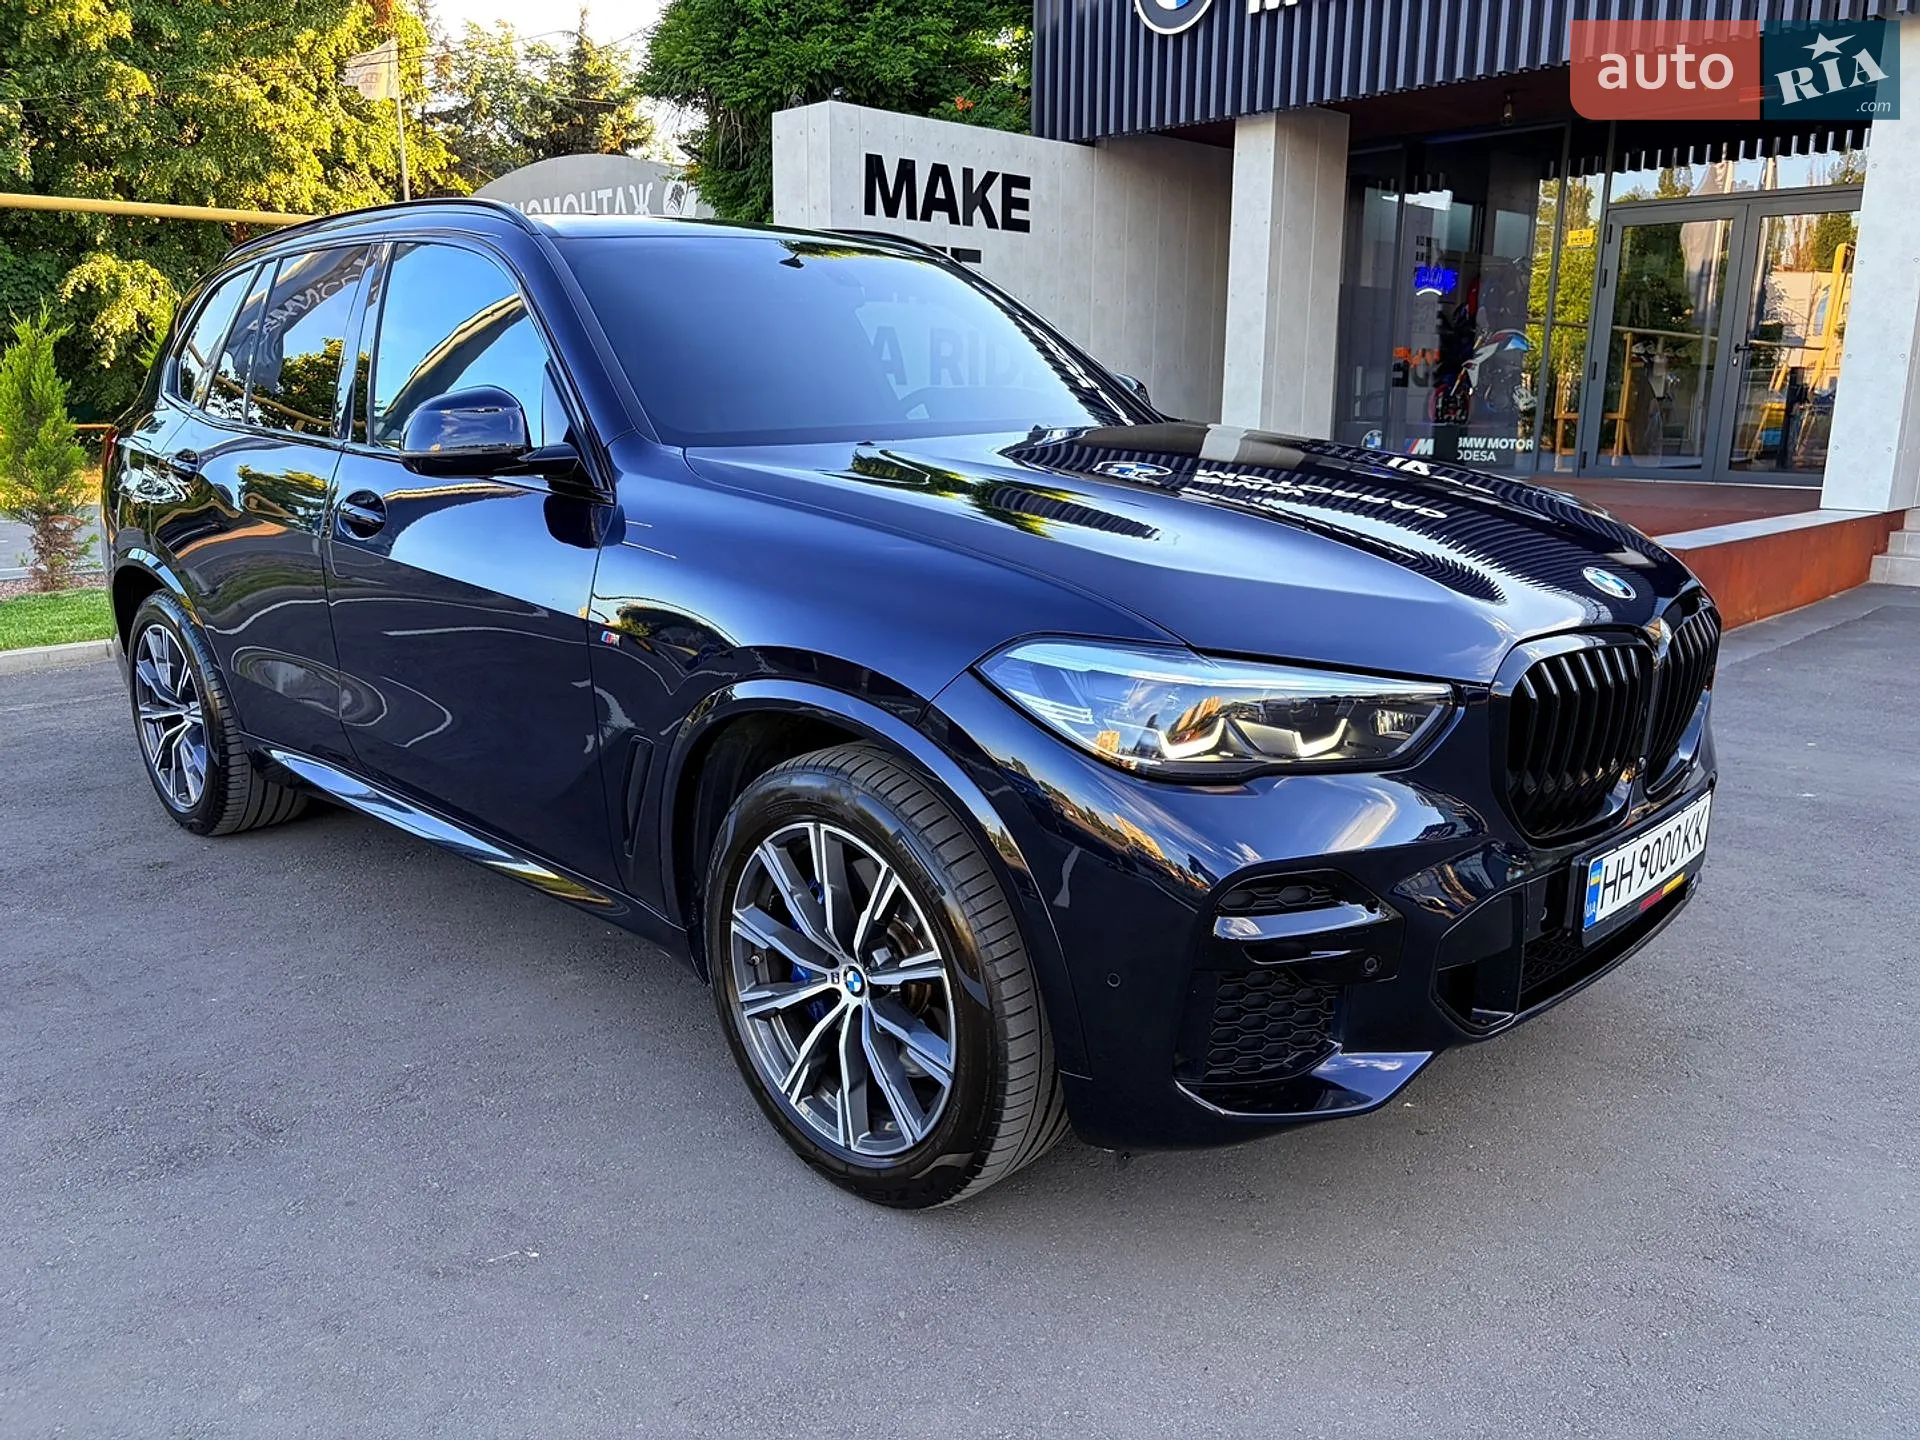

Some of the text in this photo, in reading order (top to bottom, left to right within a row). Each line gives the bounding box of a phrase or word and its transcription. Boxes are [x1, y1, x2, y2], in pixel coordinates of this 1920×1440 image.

[864, 153, 1031, 233] MAKE
[929, 327, 1030, 387] RID
[1487, 437, 1534, 450] MOTOR
